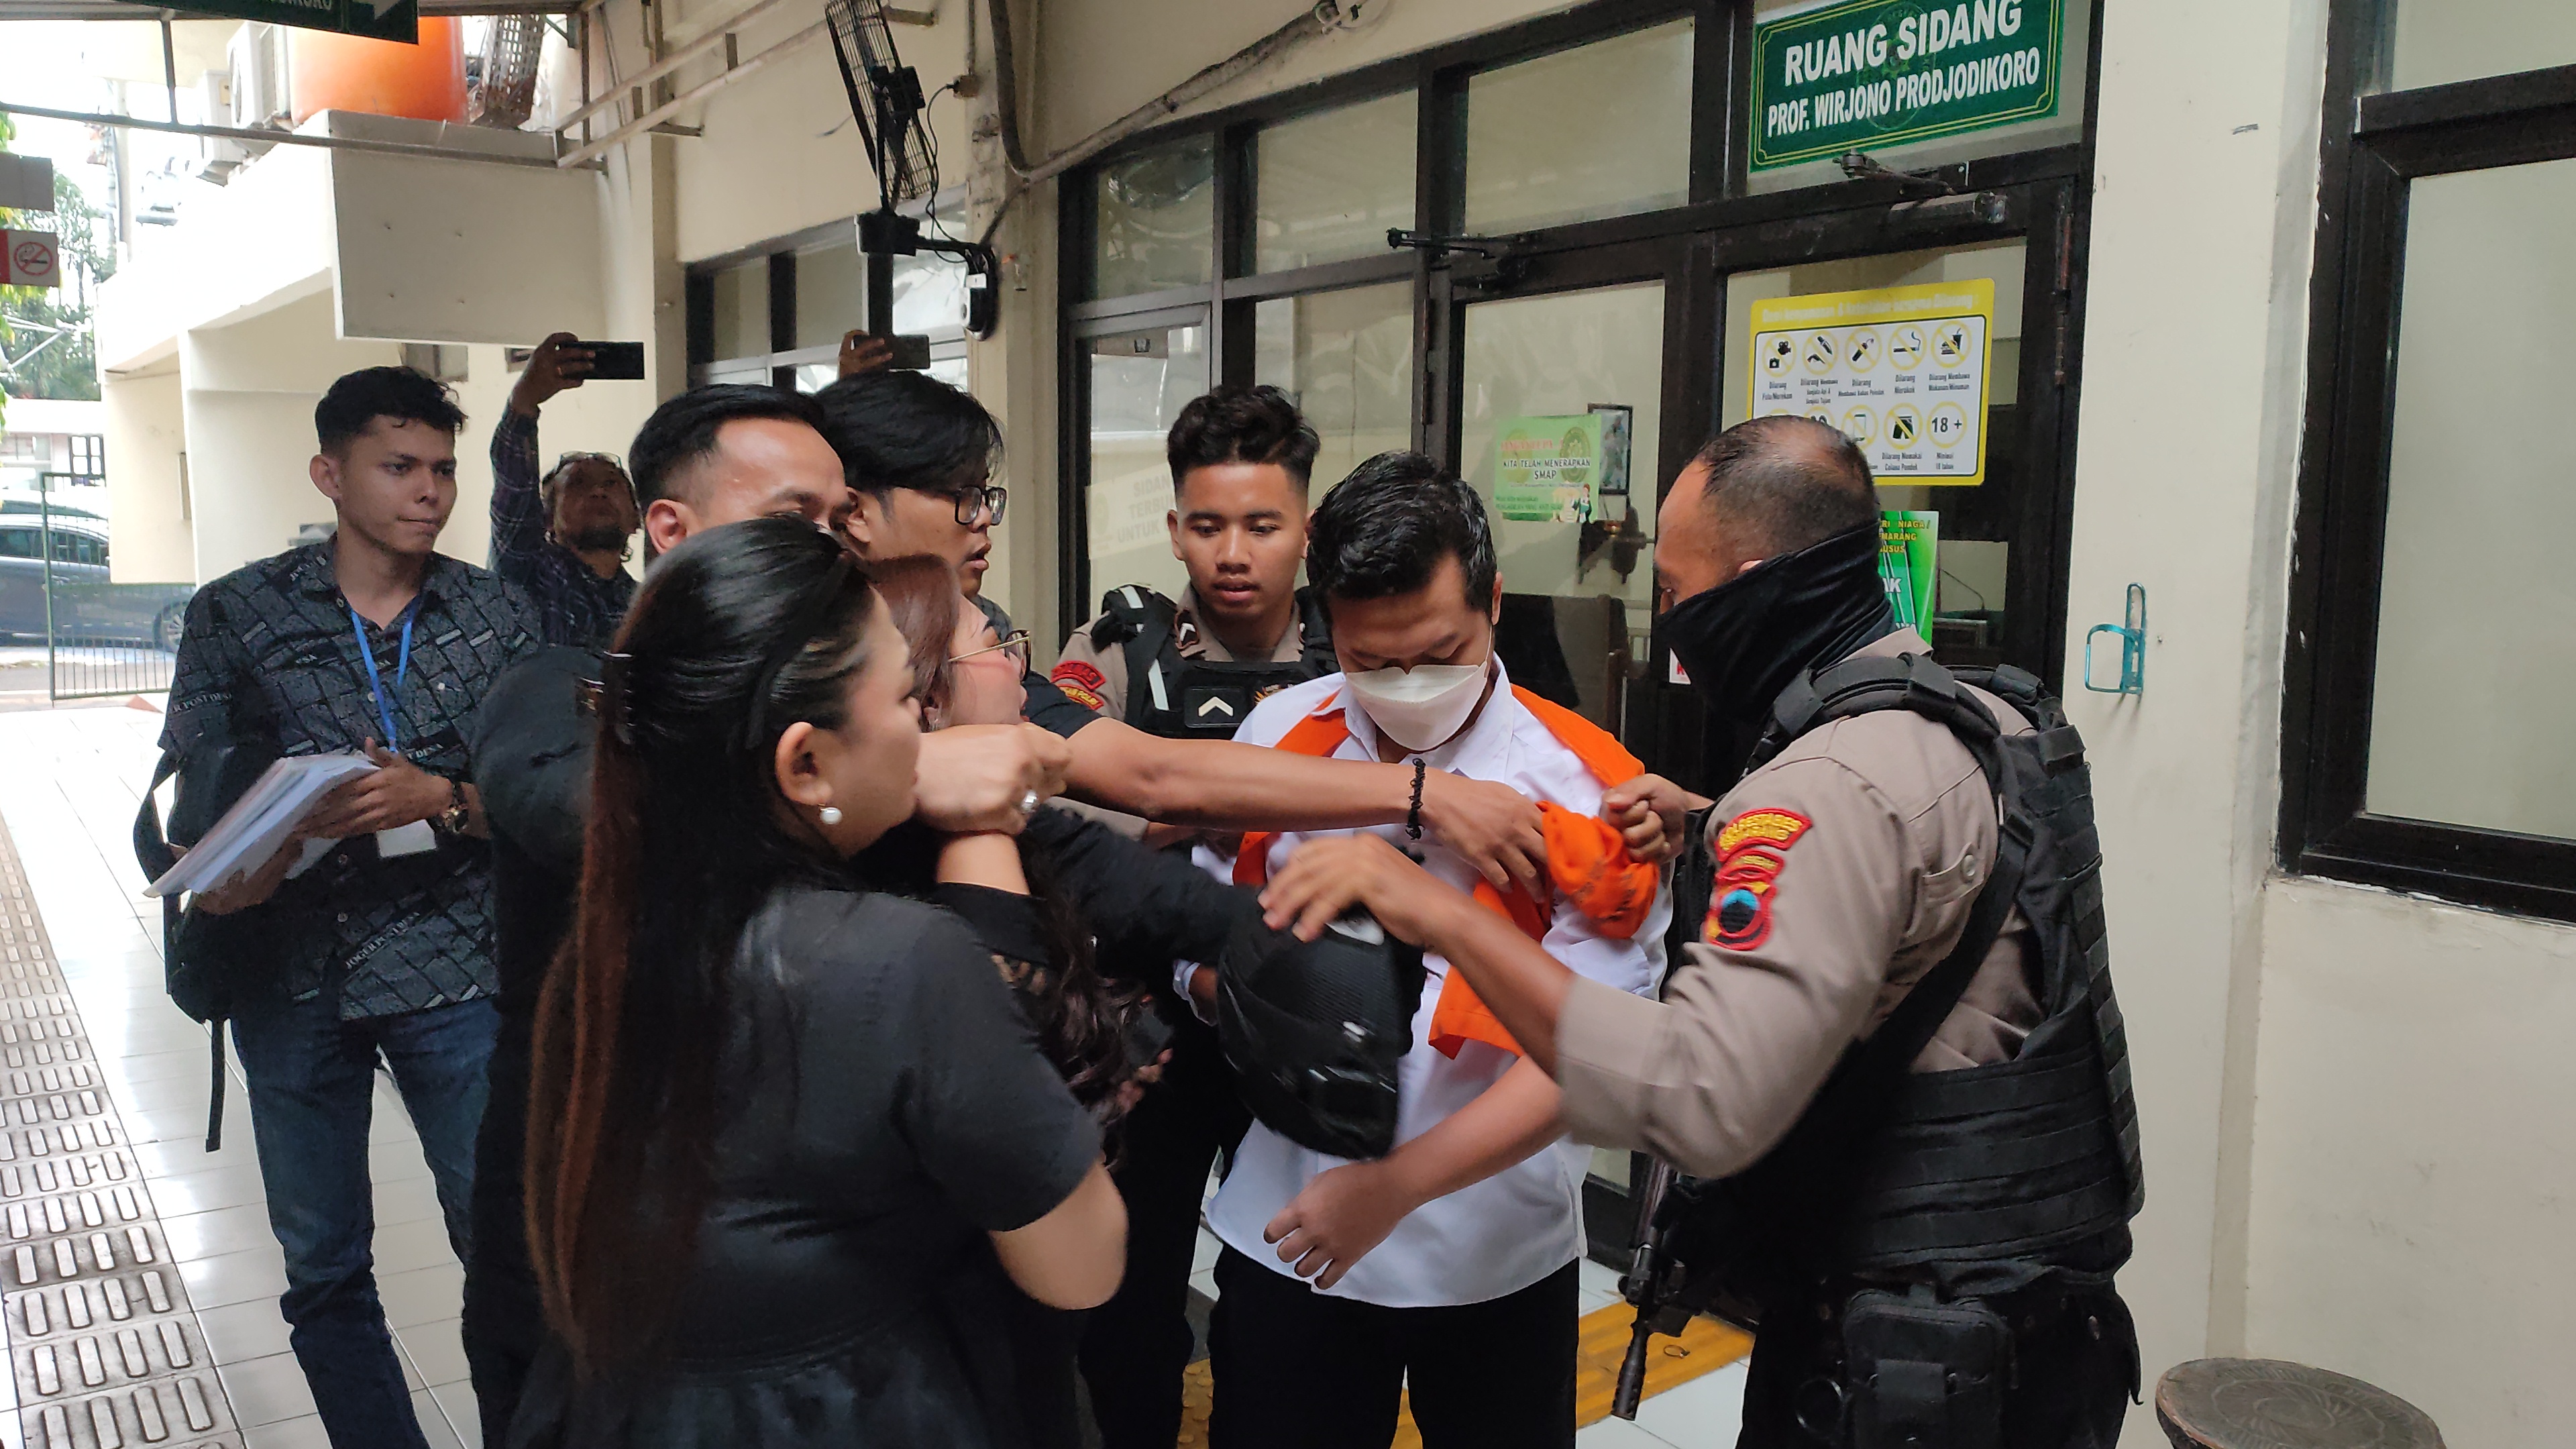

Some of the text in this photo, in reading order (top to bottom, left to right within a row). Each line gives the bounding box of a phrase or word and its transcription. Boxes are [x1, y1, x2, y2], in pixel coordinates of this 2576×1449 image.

[1784, 0, 2022, 87] RUANG SIDANG
[1767, 46, 2040, 138] PROF. WIRJONO PRODJODIKORO
[1932, 417, 1949, 433] 18
[1503, 458, 1591, 468] KITA TELAH MENERAPKAN
[1134, 474, 1172, 497] SIDAN
[1534, 470, 1557, 480] SMAP
[1129, 494, 1175, 518] TERBU
[1117, 520, 1160, 543] UNTUK
